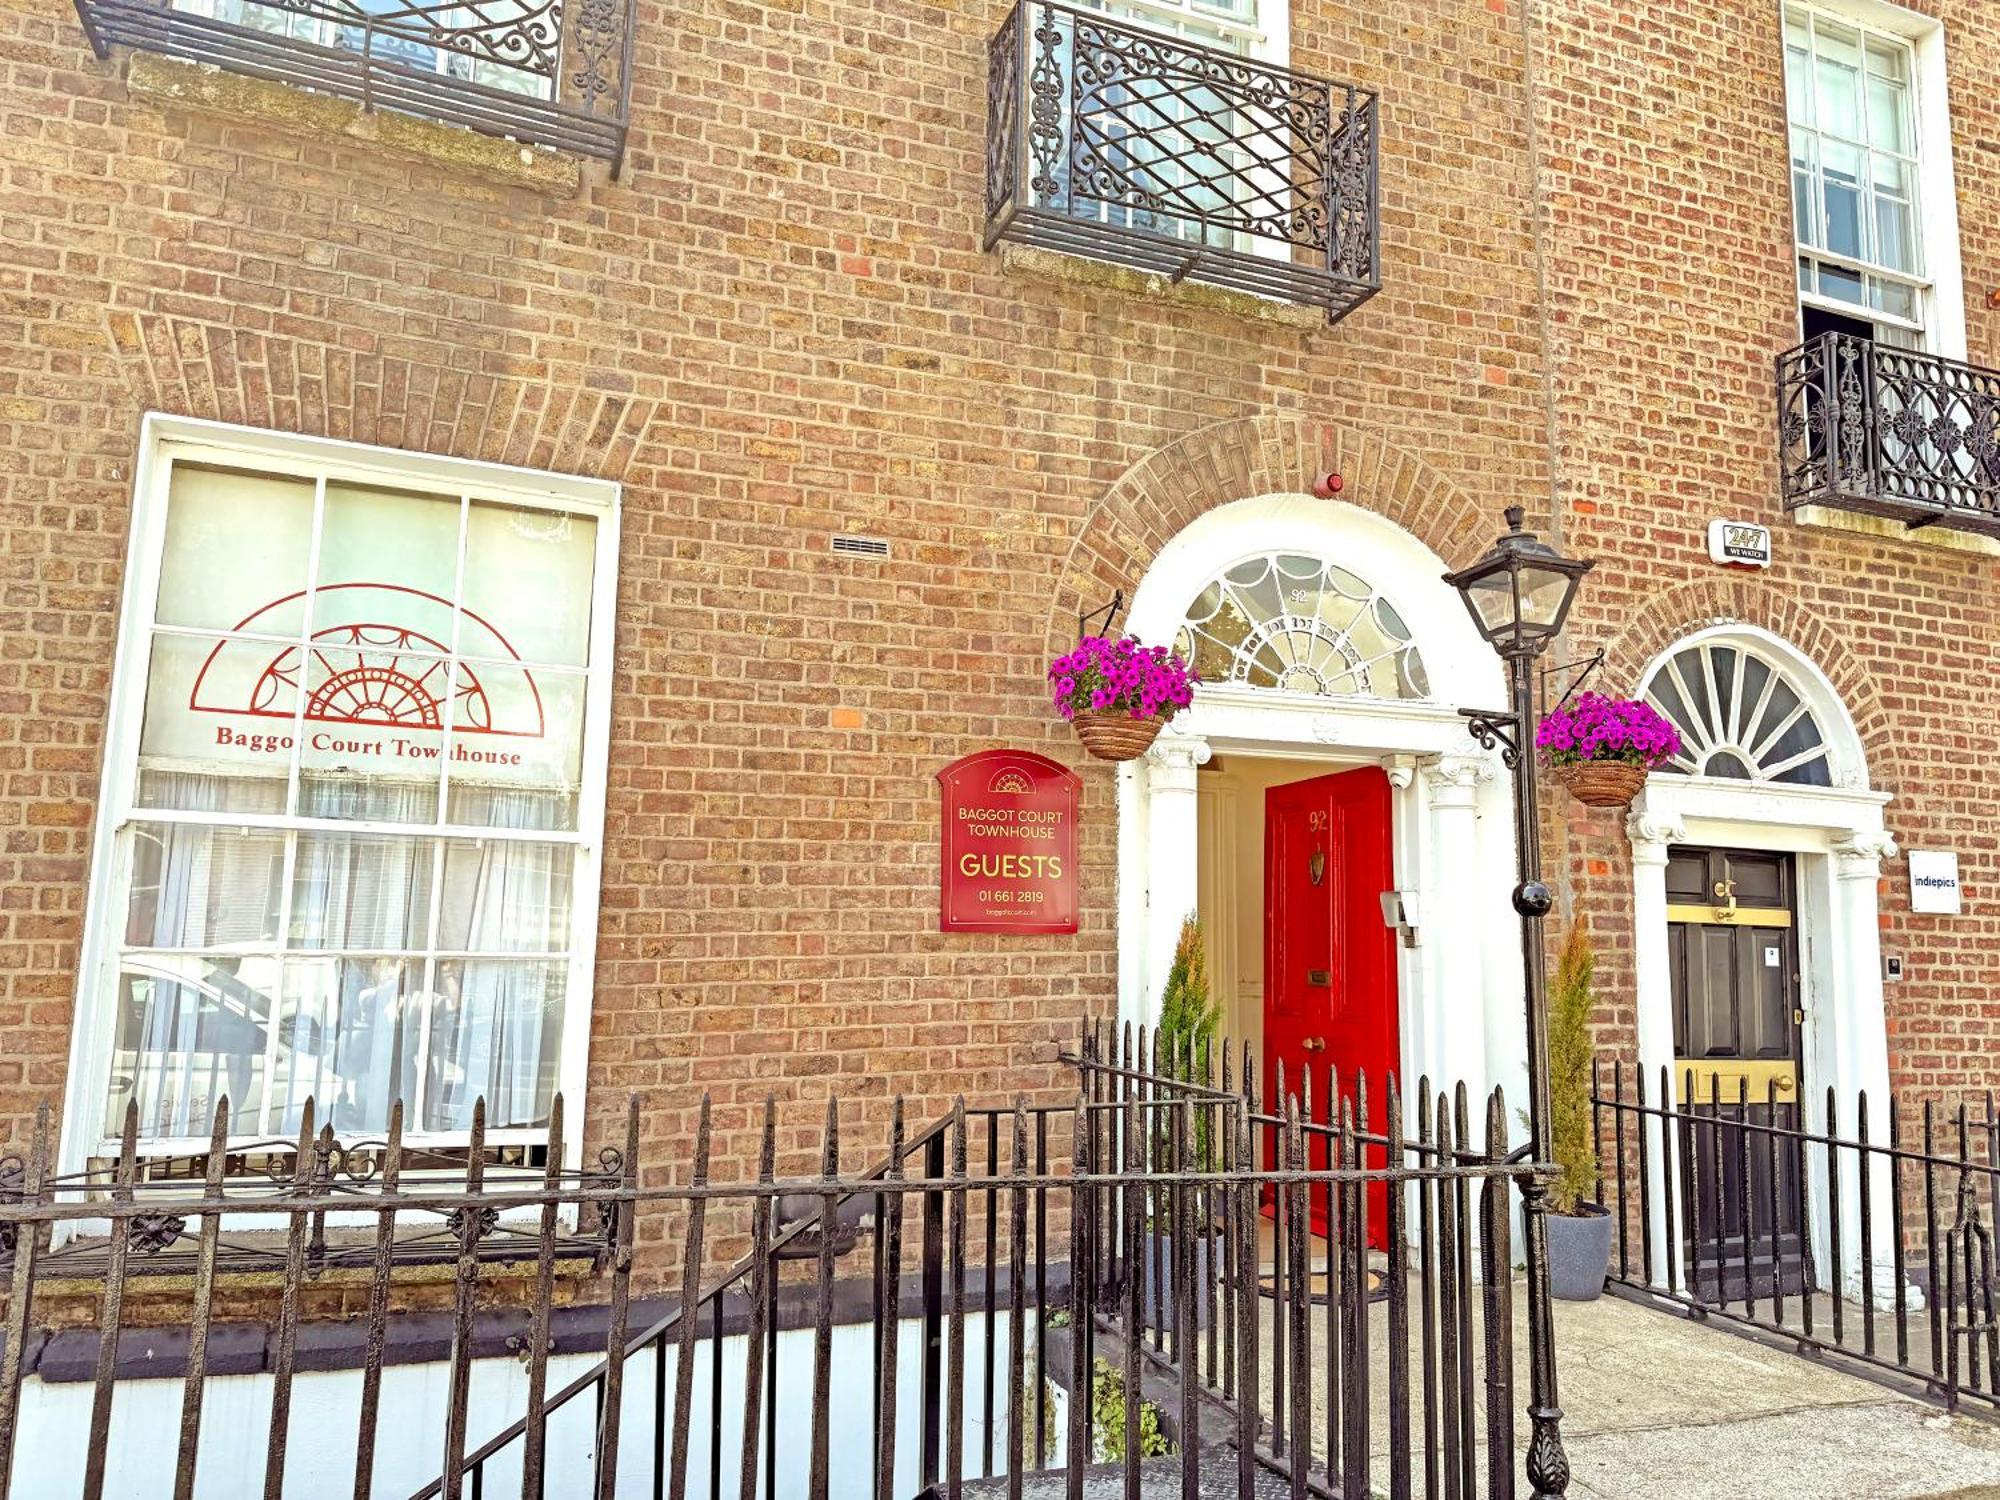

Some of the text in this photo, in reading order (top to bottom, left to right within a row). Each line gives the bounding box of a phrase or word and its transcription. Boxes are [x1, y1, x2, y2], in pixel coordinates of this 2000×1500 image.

[216, 726, 302, 753] Baggo
[312, 733, 382, 756] Court
[959, 807, 1063, 824] BAGGOT COURT
[1309, 810, 1328, 832] 92
[968, 823, 1055, 840] TOWNHOUSE
[959, 853, 1062, 879] GUESTS
[1914, 874, 1956, 890] indiepics
[979, 890, 1044, 903] 01 661 2819
